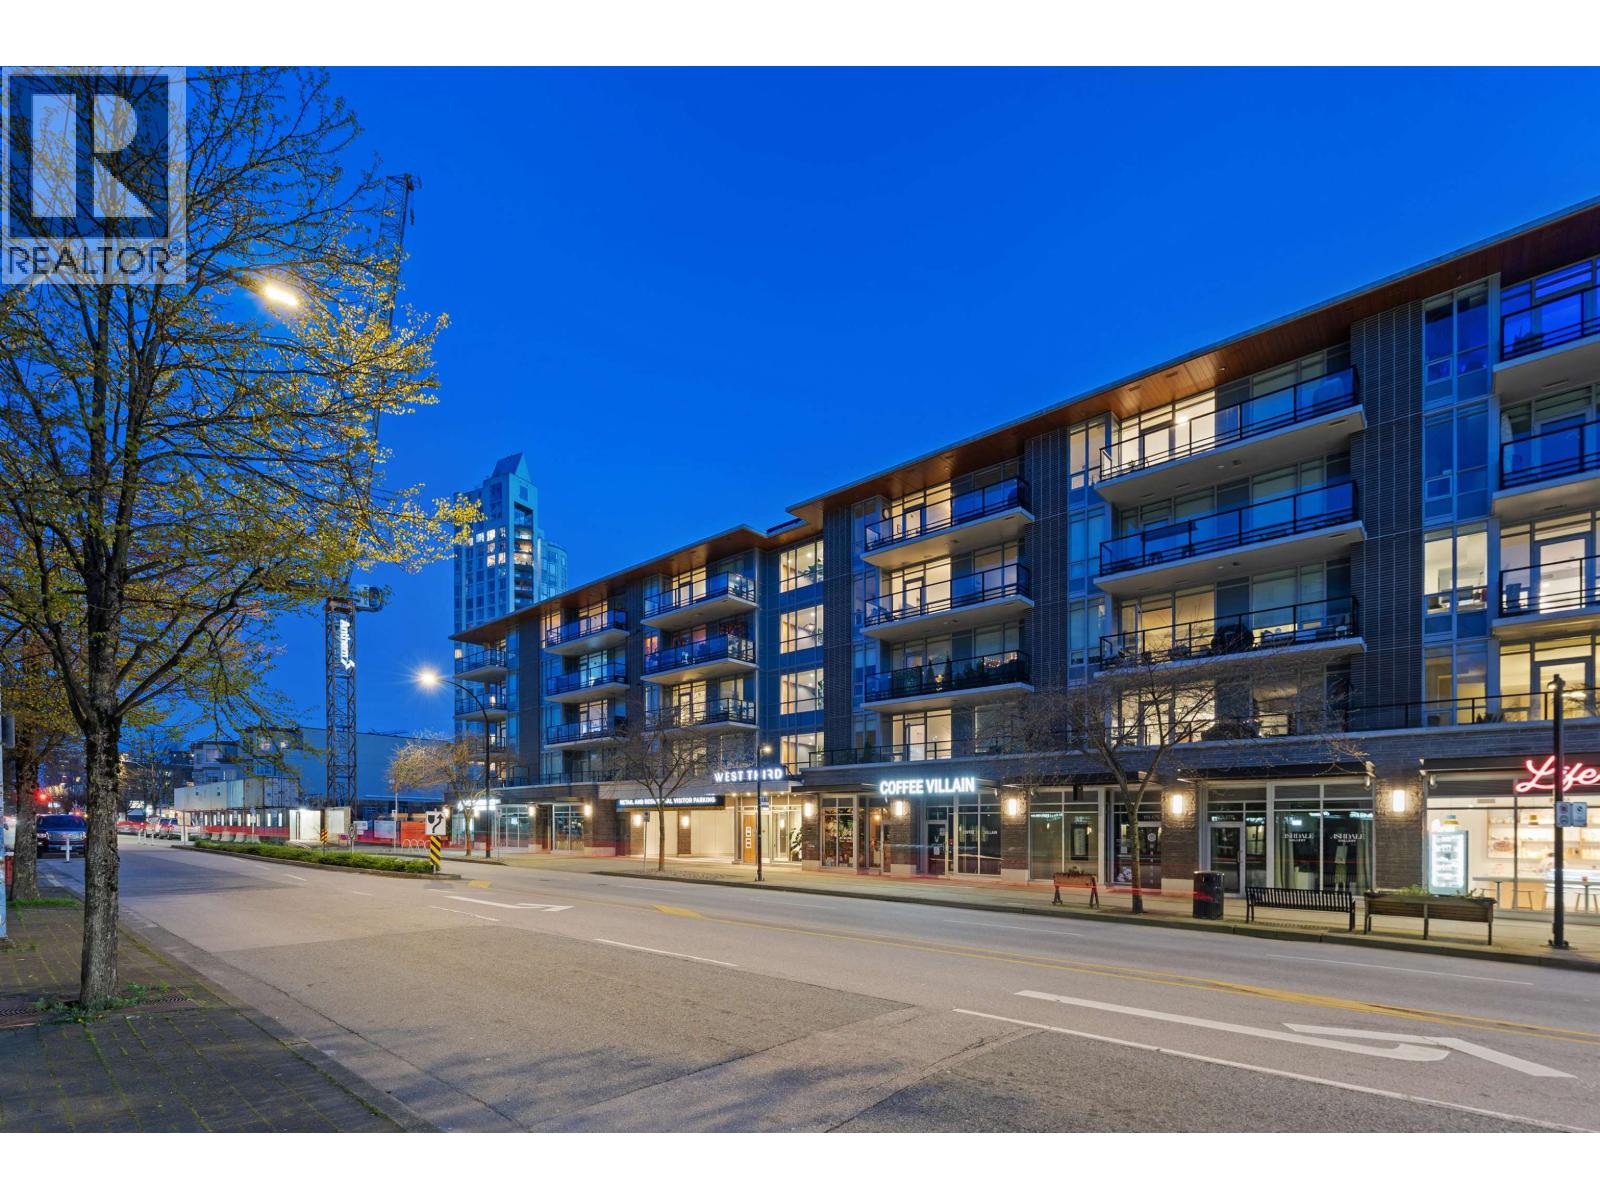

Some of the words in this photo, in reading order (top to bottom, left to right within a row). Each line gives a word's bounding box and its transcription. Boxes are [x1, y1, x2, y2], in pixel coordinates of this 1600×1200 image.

[713, 770, 744, 783] WEST
[880, 780, 924, 795] COFFEE
[925, 776, 975, 793] VILLAIN
[692, 796, 716, 804] PARKING
